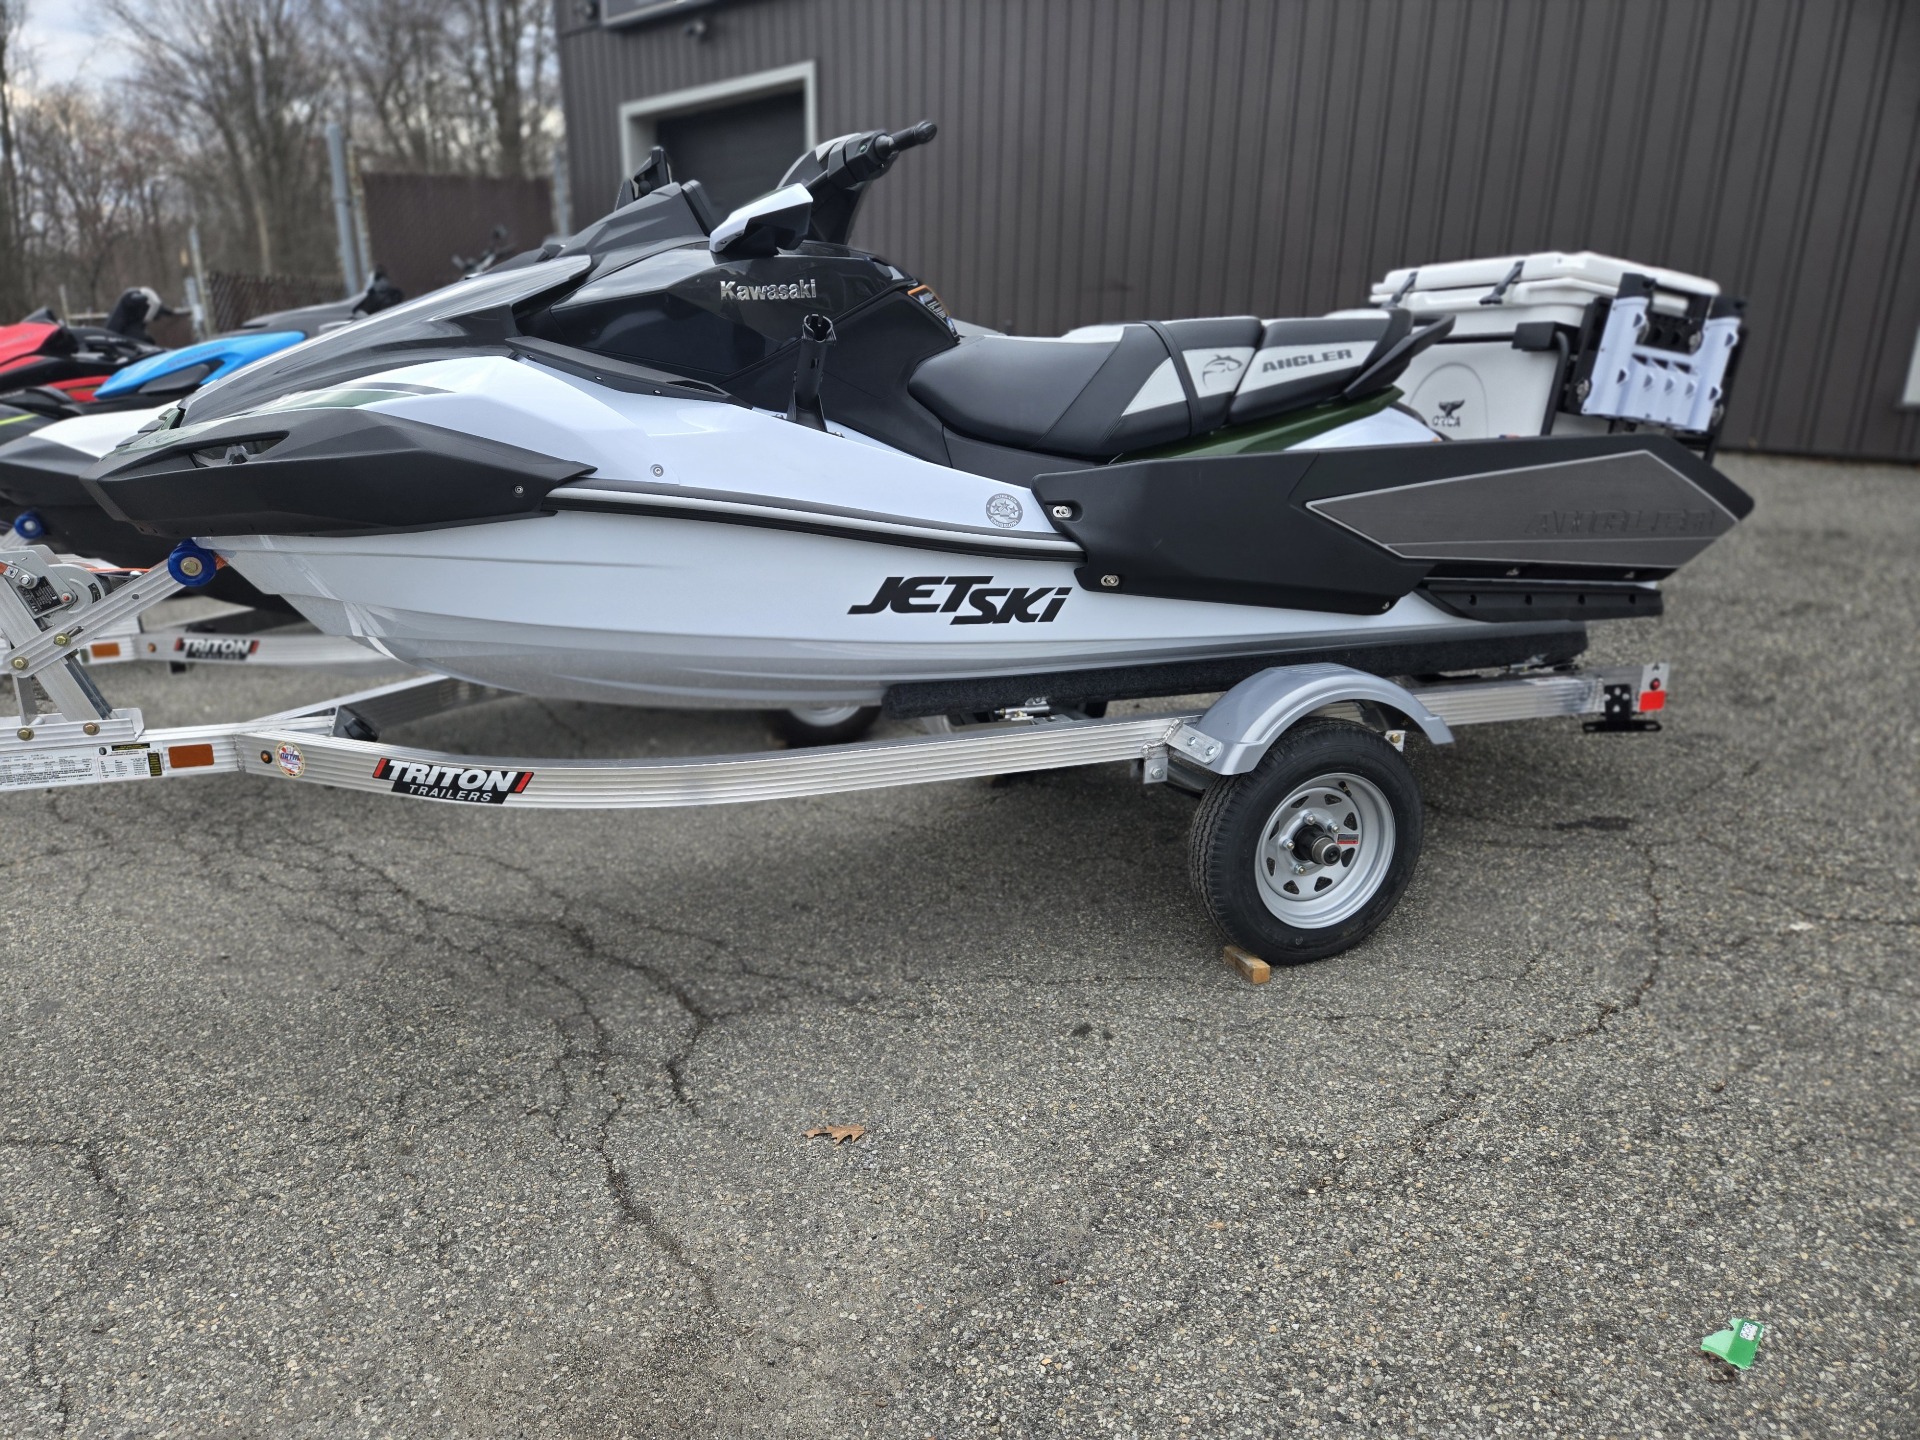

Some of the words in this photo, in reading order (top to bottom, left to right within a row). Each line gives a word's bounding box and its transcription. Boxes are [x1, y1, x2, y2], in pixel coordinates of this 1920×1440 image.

[720, 279, 817, 301] Kawasaki
[1262, 349, 1353, 373] ANGLER
[1524, 509, 1716, 535] ANGLER
[183, 638, 251, 654] TRITON
[388, 759, 518, 792] TRITON
[409, 784, 493, 802] TRAILERS
